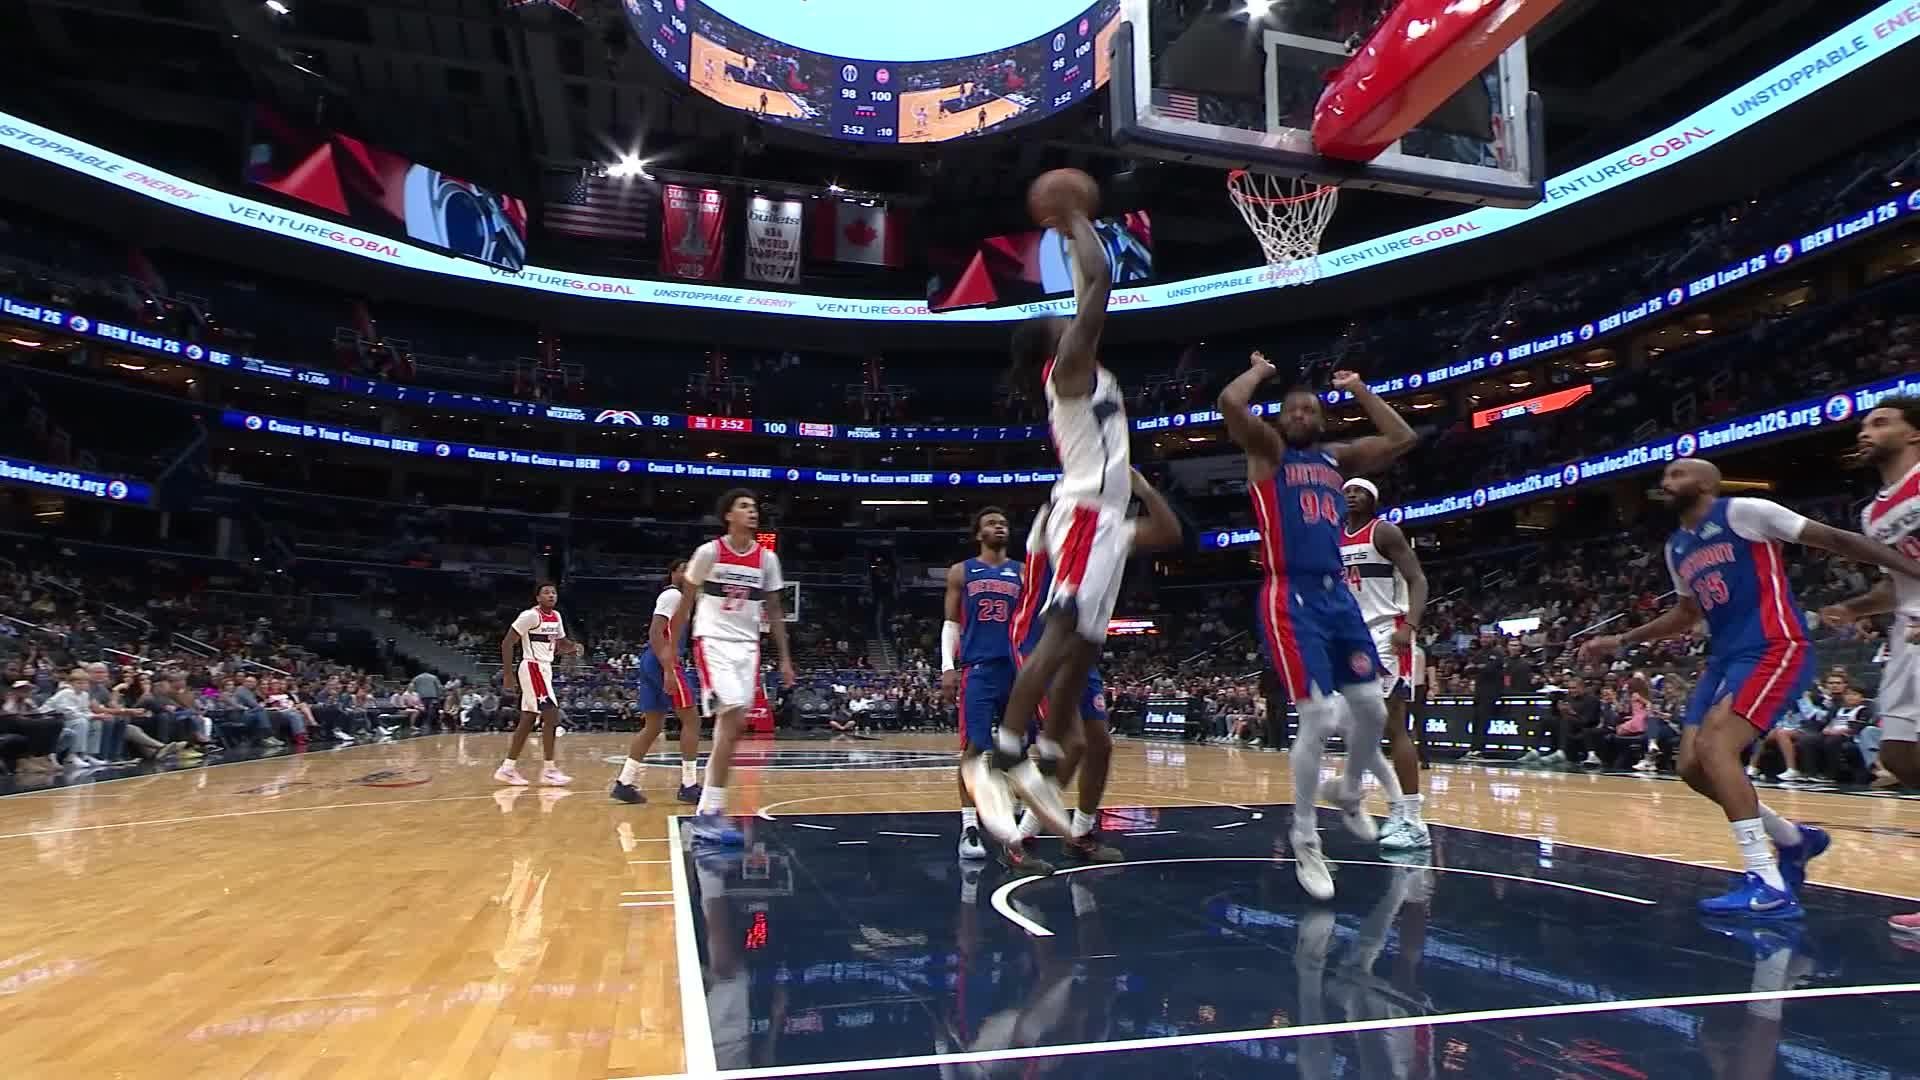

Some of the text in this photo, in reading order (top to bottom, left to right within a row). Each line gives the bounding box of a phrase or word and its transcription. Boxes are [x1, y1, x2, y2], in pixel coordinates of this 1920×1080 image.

[1731, 35, 1869, 117] UNSTOPPABLE
[841, 88, 892, 102] 98 100
[842, 125, 864, 135] 3:52
[1836, 210, 1874, 238] Local
[1876, 201, 1898, 223] 26
[1717, 262, 1749, 285] Local
[1749, 254, 1767, 273] 26
[653, 288, 744, 304] UNSTOPPABLE
[1622, 302, 1647, 323] Local
[1648, 297, 1662, 313] 26
[42, 309, 62, 325] 26
[130, 330, 162, 349] Local
[164, 339, 180, 353] 26
[1533, 335, 1559, 353] Local
[1560, 331, 1574, 345] 26
[1449, 361, 1472, 376] Local
[1472, 357, 1485, 370] 26
[1391, 379, 1404, 391] 26
[546, 409, 586, 421] WIZARDS
[652, 415, 670, 426] 98
[720, 419, 744, 430] 3:52
[763, 422, 787, 434] 100
[847, 431, 880, 439] PISTONS
[1136, 418, 1157, 430] Local
[1158, 416, 1169, 427] 26
[1699, 405, 1822, 449] ibewlocal26.org
[1581, 441, 1674, 479] ibewlocal26.org
[1300, 488, 1340, 527] 94
[977, 598, 1008, 622] 23
